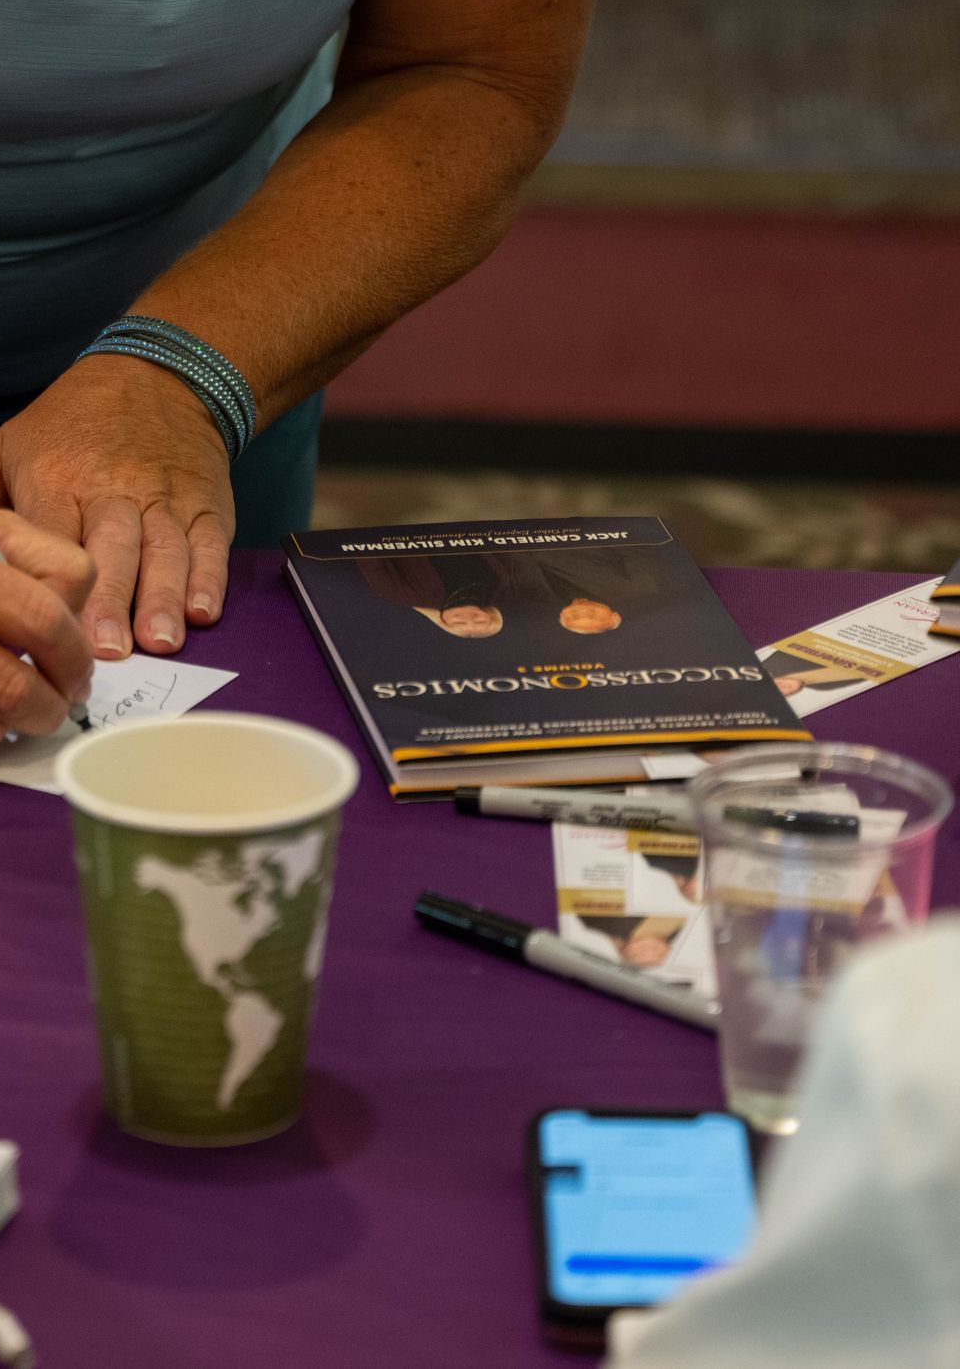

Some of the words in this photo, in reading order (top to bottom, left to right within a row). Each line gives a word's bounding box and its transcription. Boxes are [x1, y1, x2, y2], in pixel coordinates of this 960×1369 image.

[488, 534, 581, 544] CANFIELD,
[585, 532, 628, 540] JACK
[341, 540, 444, 552] SILVERMAN
[449, 538, 484, 546] KIM
[786, 642, 857, 670] Silverman
[531, 662, 604, 672] VOLUME
[373, 667, 763, 699] SUCCESSONOMICS
